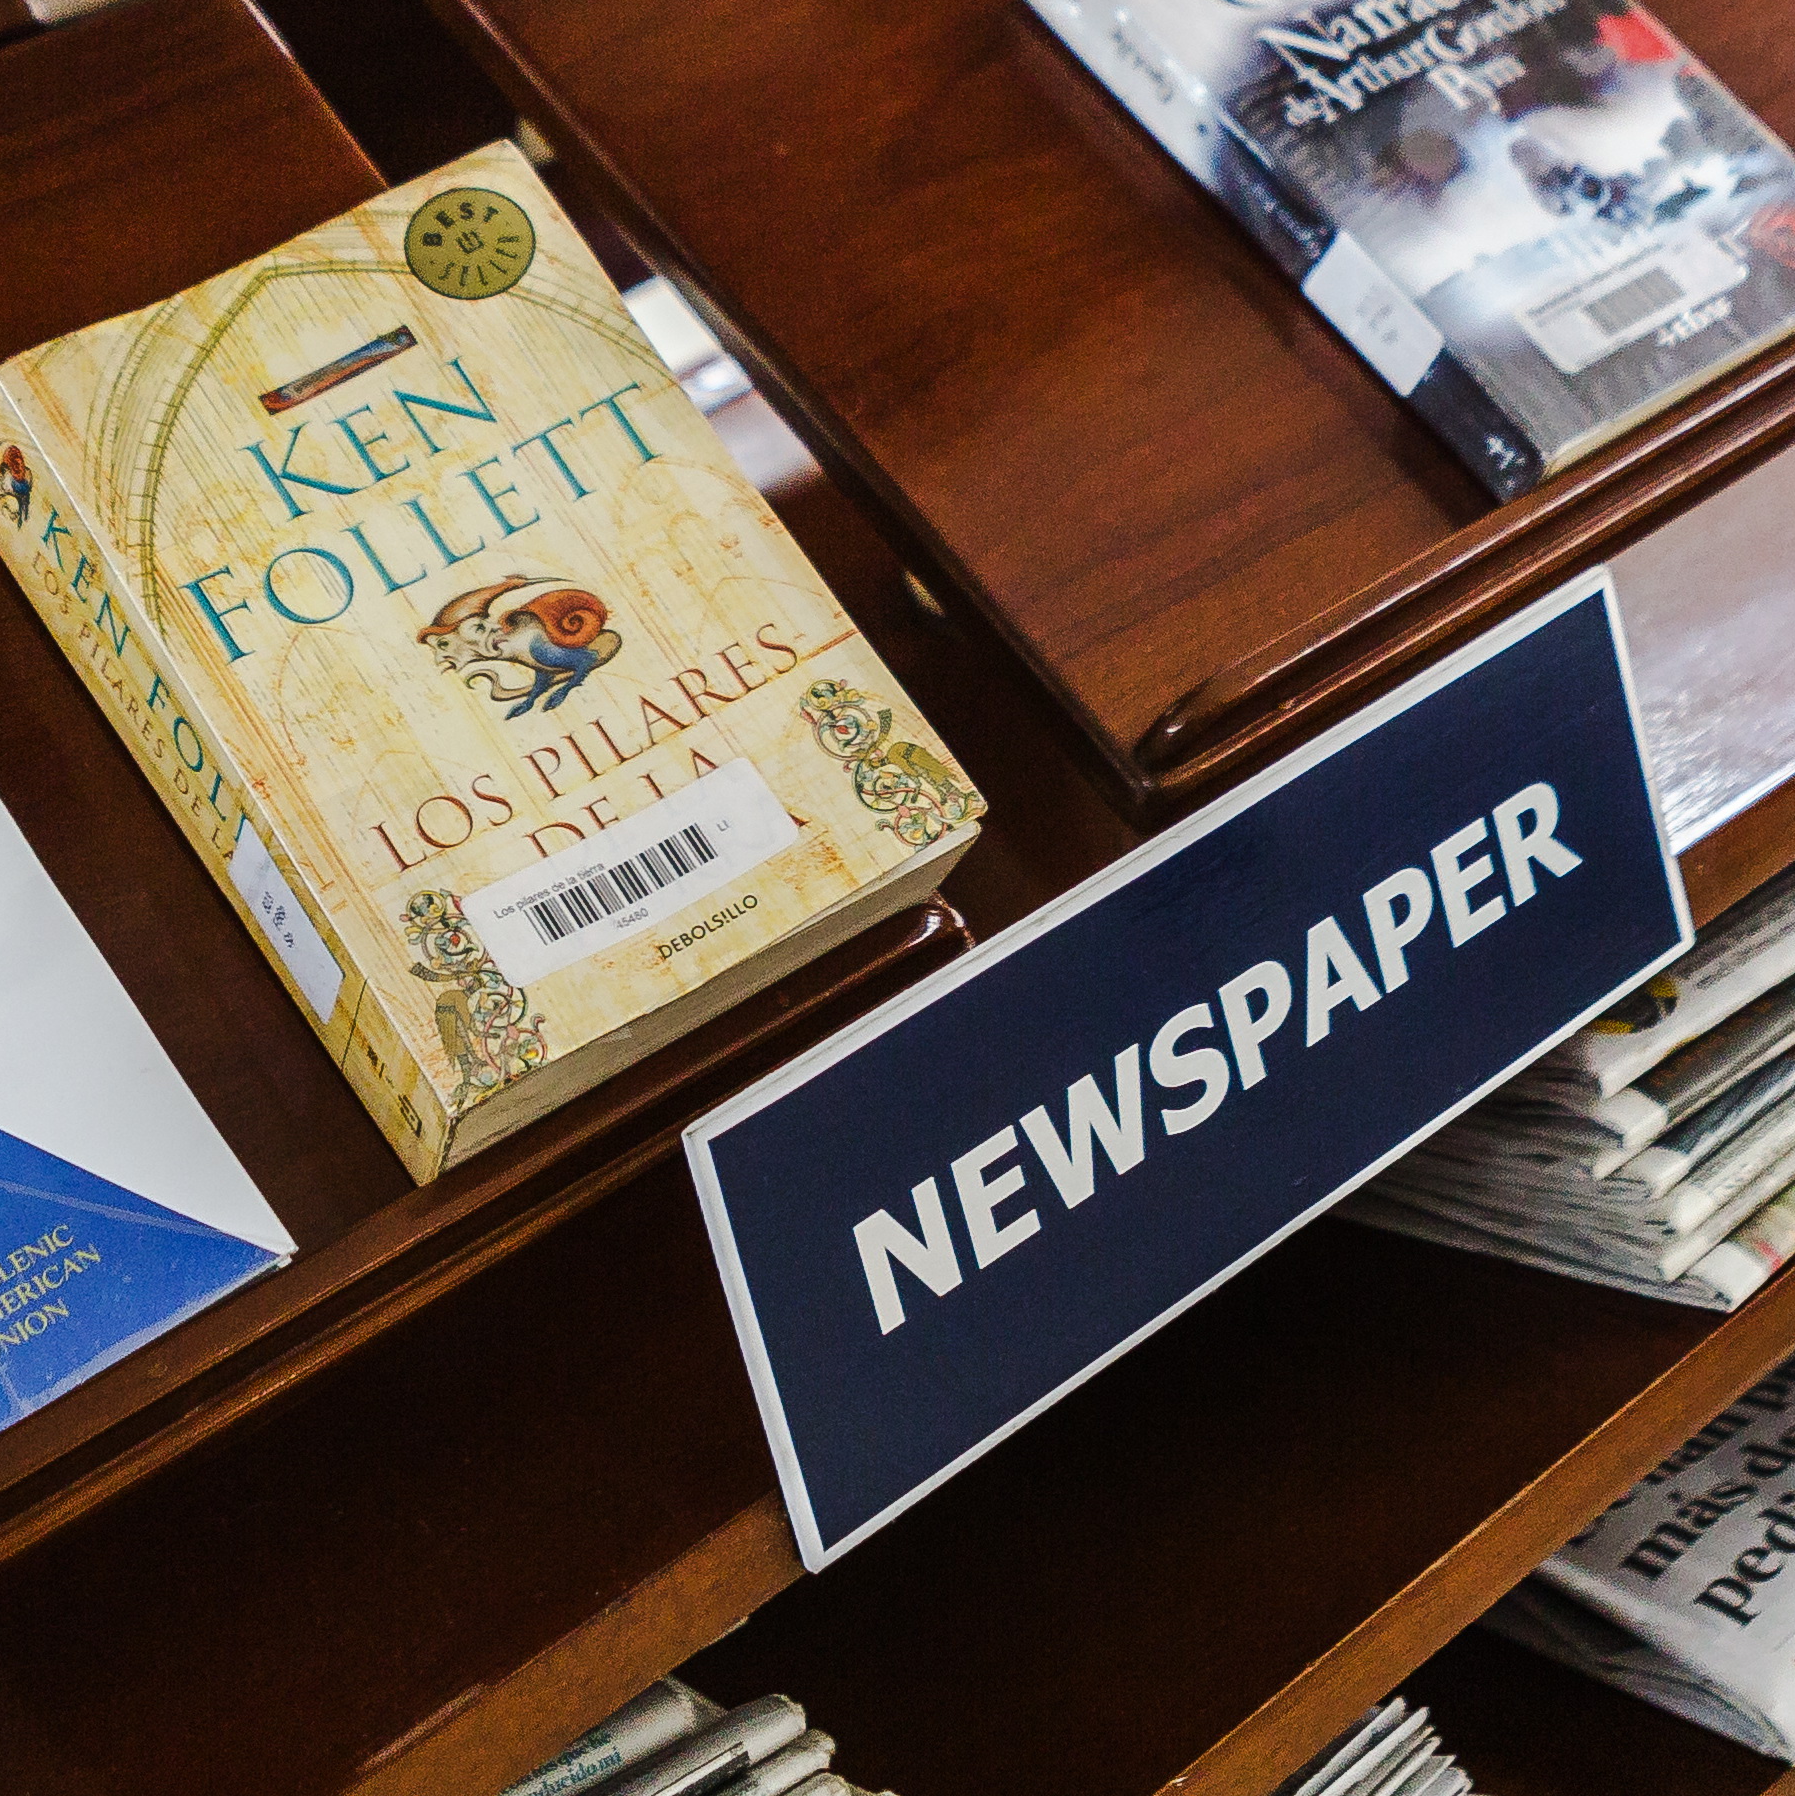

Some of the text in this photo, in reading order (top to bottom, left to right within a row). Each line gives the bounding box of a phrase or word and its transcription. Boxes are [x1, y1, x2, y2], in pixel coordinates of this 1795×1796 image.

[1299, 34, 1434, 112] Arthur
[421, 204, 502, 250] BEST
[234, 352, 502, 522] KEN
[40, 504, 132, 659] KEN
[177, 380, 672, 668] FOLLETT
[31, 550, 72, 616] LOS
[77, 622, 168, 760] PILARES
[172, 769, 205, 820] DE
[369, 621, 800, 874] LOS PILARES
[492, 904, 516, 921] Los
[551, 880, 567, 897] de
[566, 873, 578, 888] la
[659, 894, 759, 961] DEBOLS!LLO
[850, 777, 1584, 1338] NEWSPAPER
[1619, 1481, 1757, 1583] más
